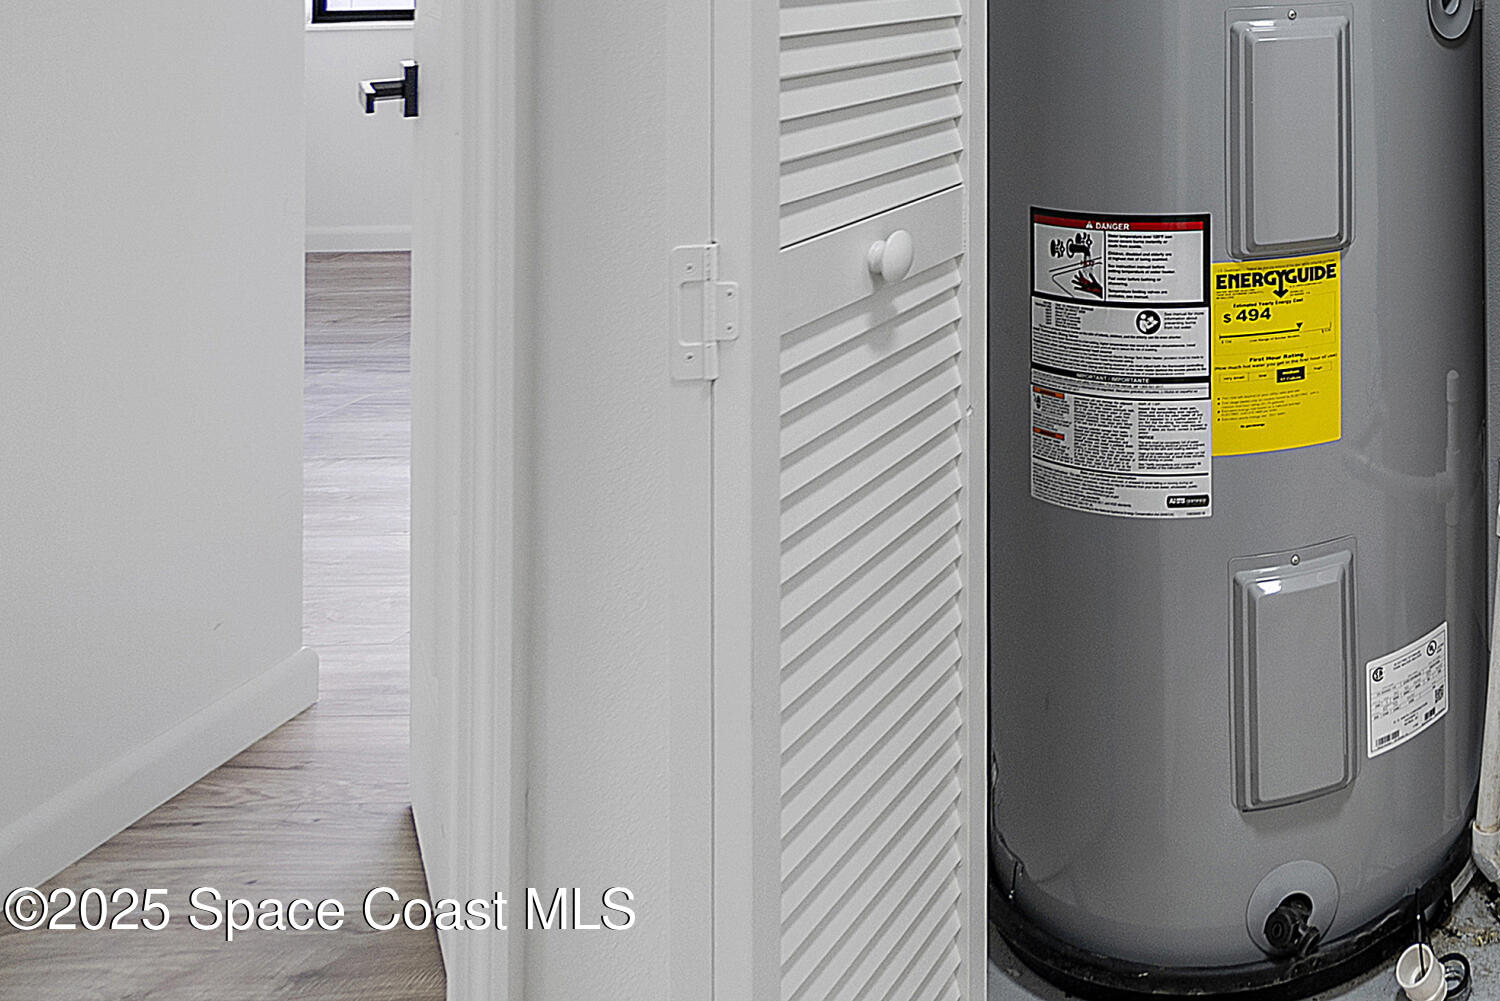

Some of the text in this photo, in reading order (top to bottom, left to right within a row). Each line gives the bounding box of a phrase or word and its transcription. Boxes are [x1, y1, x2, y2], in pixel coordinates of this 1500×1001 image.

[1095, 221, 1130, 231] DANGER
[1216, 263, 1337, 298] ENERGYGUIDE
[1235, 307, 1271, 322] 494
